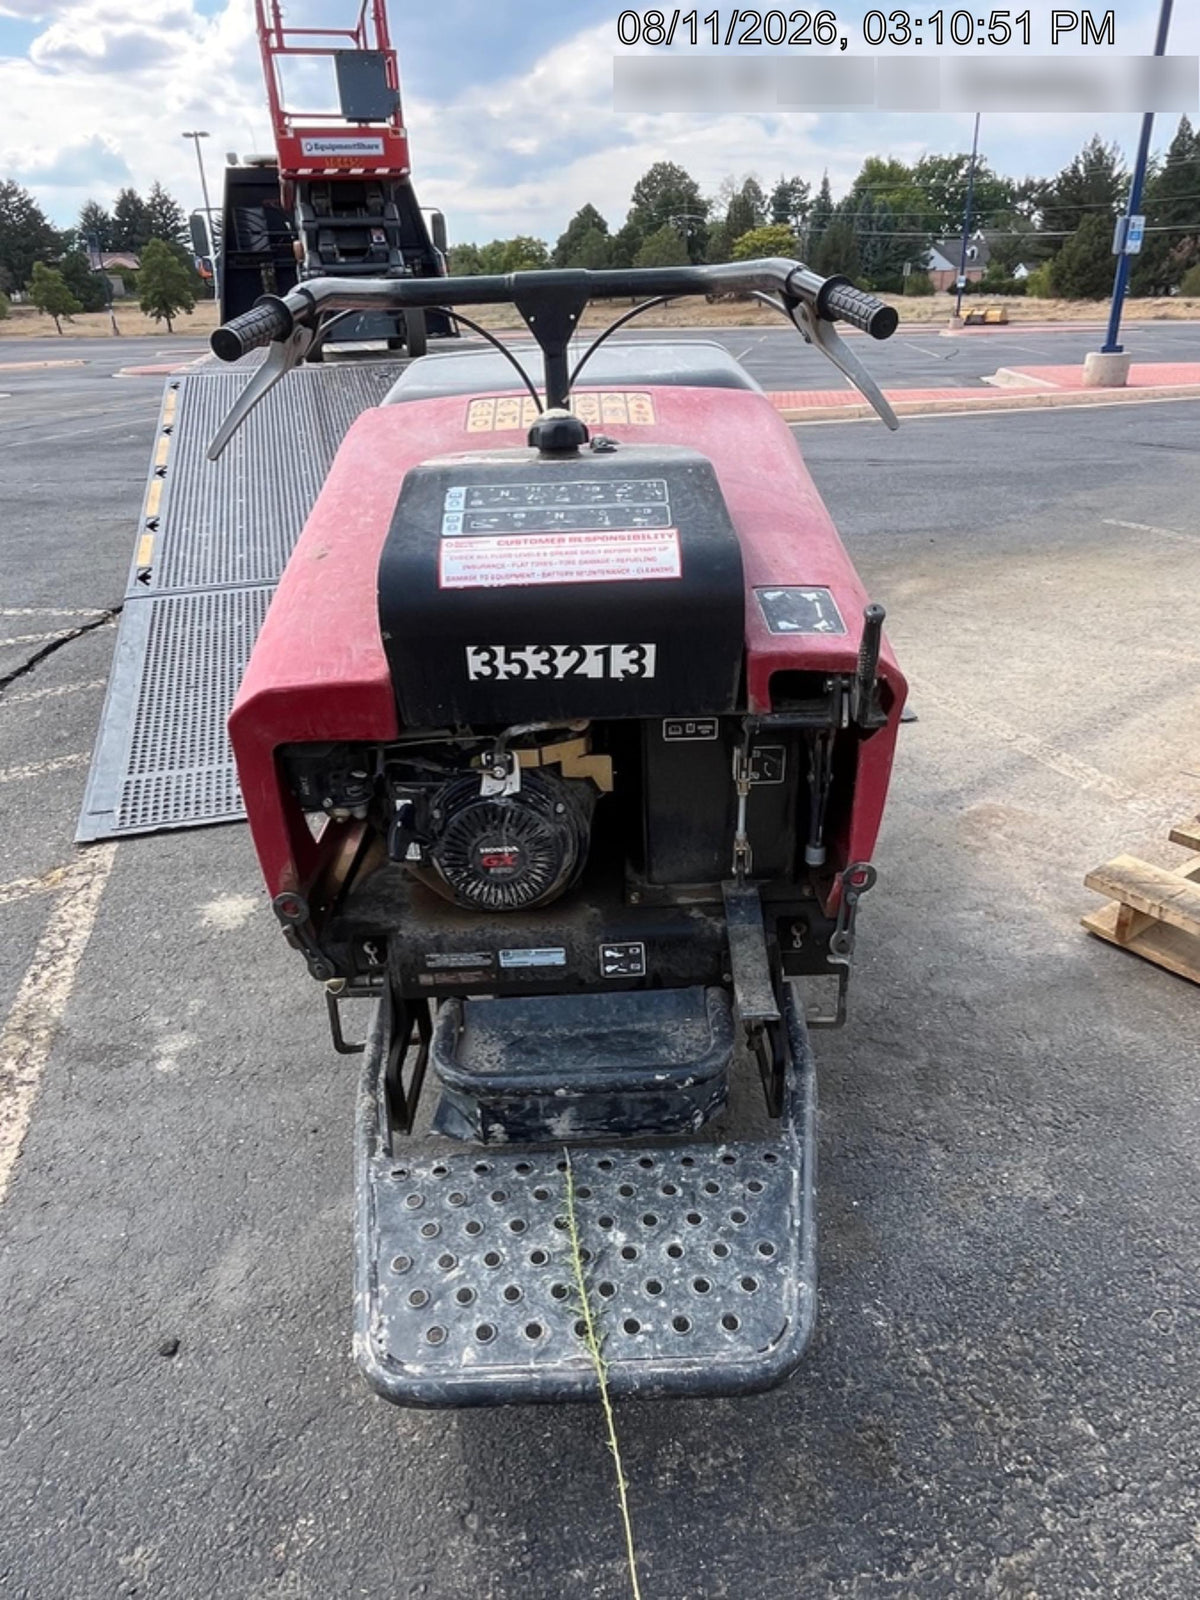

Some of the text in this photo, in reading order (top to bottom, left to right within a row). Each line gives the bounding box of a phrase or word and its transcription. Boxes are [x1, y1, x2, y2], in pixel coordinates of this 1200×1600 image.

[314, 142, 379, 152] EquipmentShare
[497, 537, 566, 547] CUSTOMER
[568, 532, 674, 543] RESPONSIBILITY
[491, 572, 535, 580] EQUIPMENT
[636, 566, 674, 574] CLEANING
[470, 644, 649, 680] 353213
[479, 845, 520, 854] HONDA
[483, 854, 518, 867] GX
